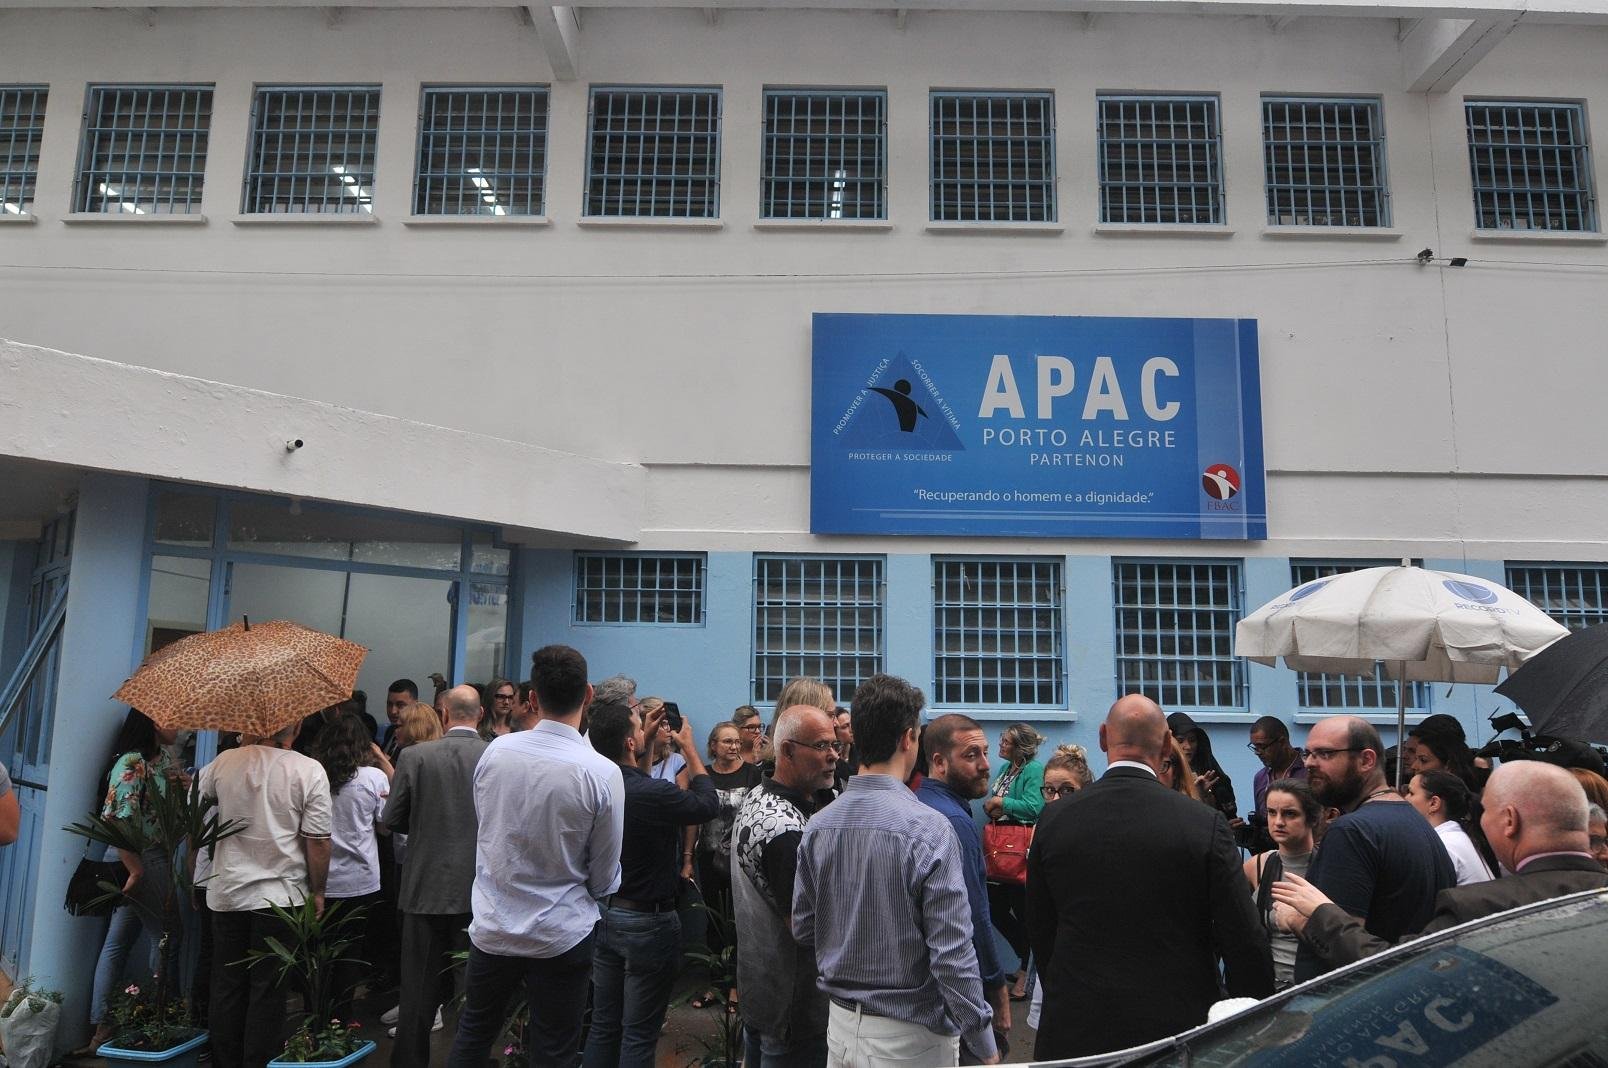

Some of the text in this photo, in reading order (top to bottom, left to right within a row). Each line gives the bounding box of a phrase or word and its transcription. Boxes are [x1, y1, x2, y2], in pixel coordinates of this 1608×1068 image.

[911, 359, 939, 397] SOCORRER
[941, 402, 962, 431] VÍTIMA
[978, 354, 1181, 422] APAC
[833, 358, 890, 435] PROMOVER A JUSTIÇA
[983, 428, 1176, 448] PORTO ALEGRE
[848, 452, 952, 462] PROTEGER A SOCIEDADE
[1030, 453, 1123, 466] PARTENON
[1003, 493, 1011, 502] o
[1014, 490, 1062, 503] homem
[1065, 494, 1072, 503] e
[1075, 494, 1083, 503] a
[1206, 501, 1239, 511] FBAC
